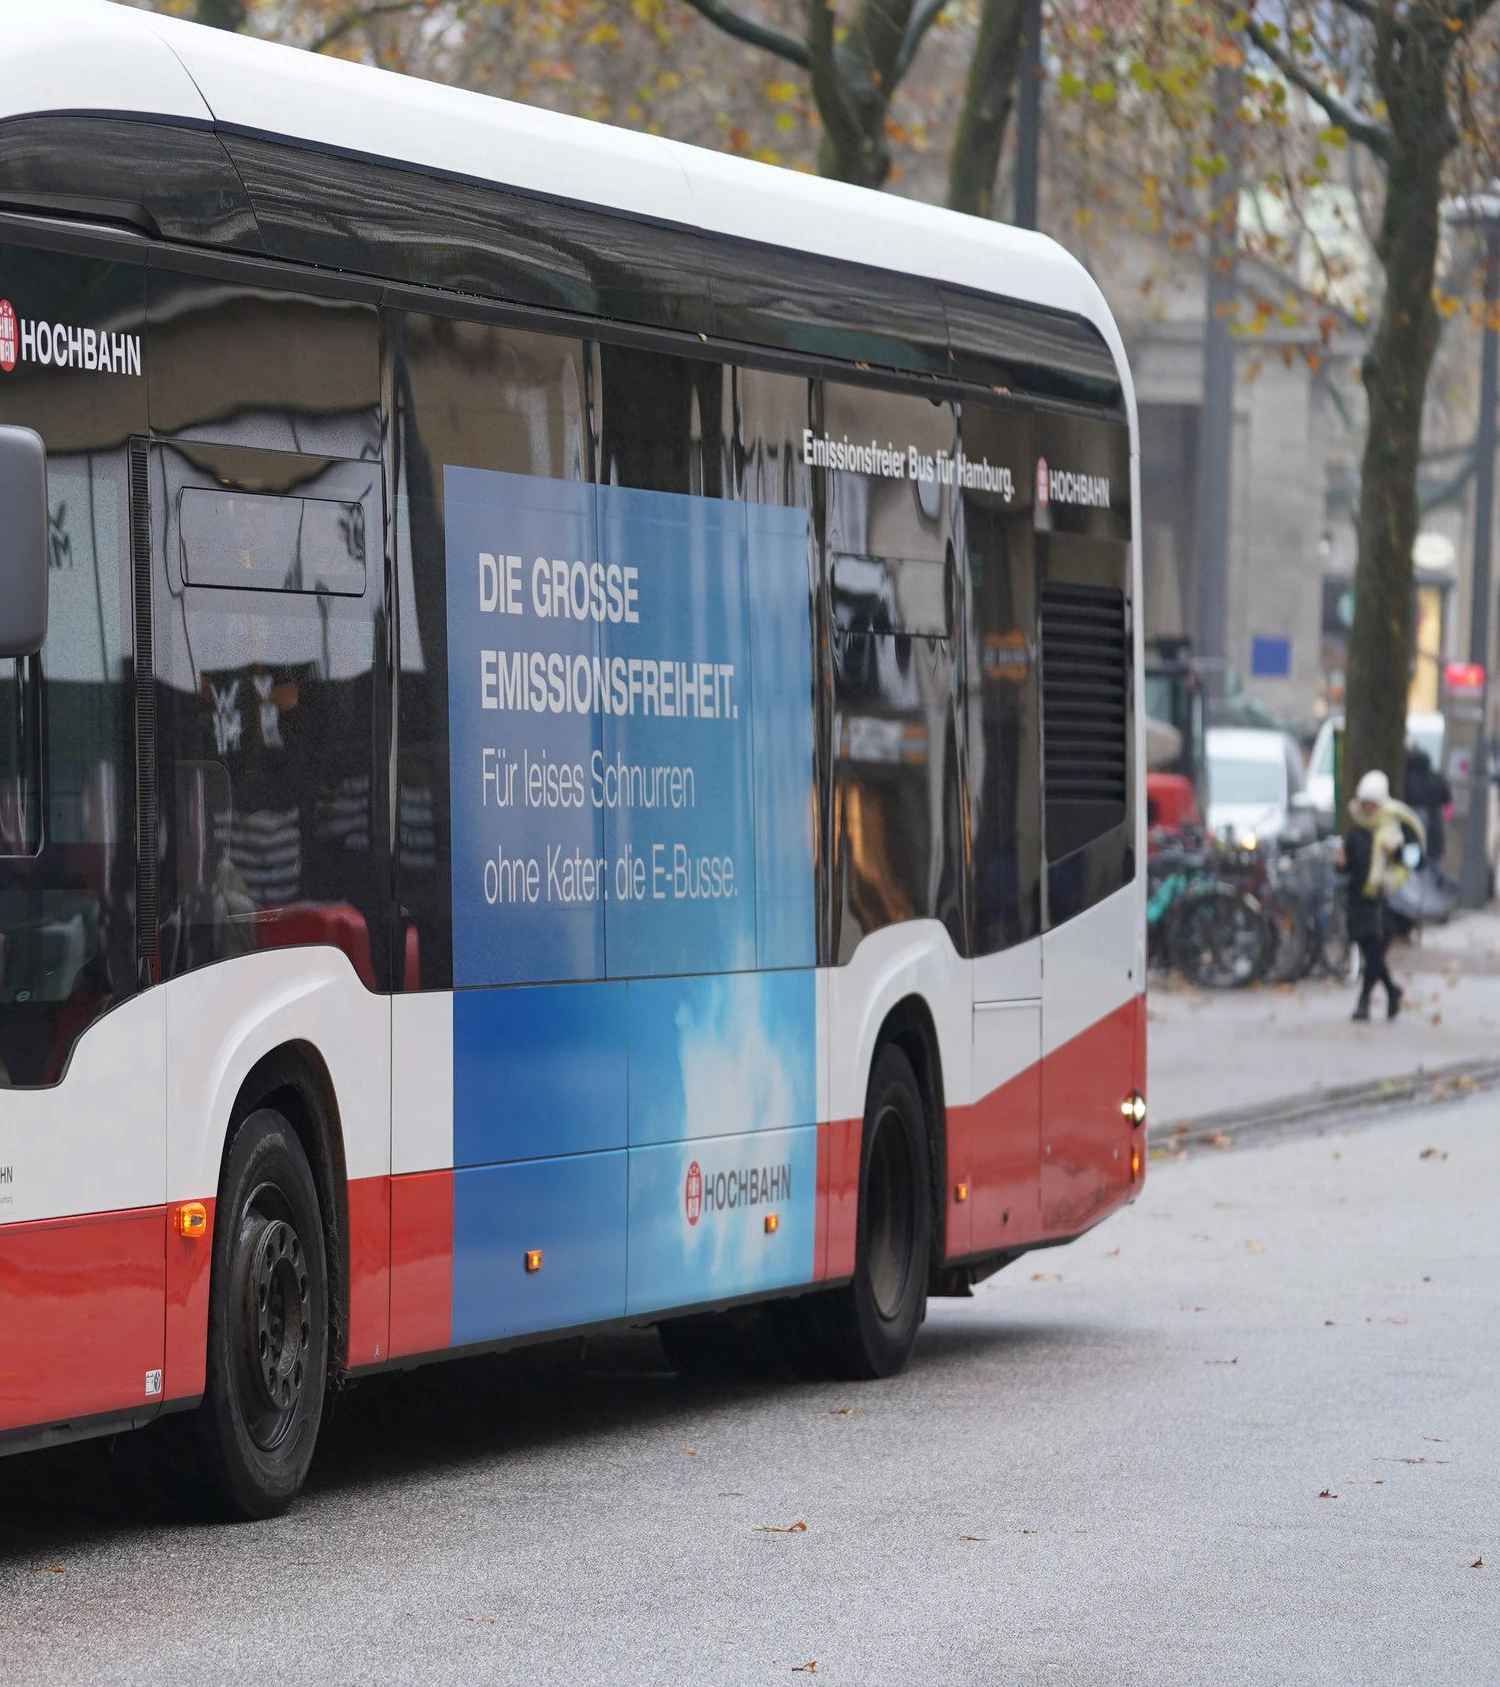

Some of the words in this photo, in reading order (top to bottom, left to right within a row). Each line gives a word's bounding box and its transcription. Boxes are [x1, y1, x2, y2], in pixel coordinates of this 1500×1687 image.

[20, 318, 142, 377] HOCHBAHN
[803, 428, 906, 478] Emissionsfreier
[908, 445, 935, 483] Bus
[936, 449, 956, 485] für
[957, 453, 1016, 503] Hamburg.
[1050, 469, 1110, 508] HOCHBAHN
[478, 552, 523, 615] DIE
[531, 556, 640, 623] GROSSE
[480, 649, 739, 720] EMISSIONSFREIHEIT.
[482, 747, 518, 808] Für
[524, 749, 585, 808] leises
[590, 749, 696, 809] Schnurren
[483, 844, 540, 905] ohne
[547, 844, 609, 902] Kater:
[615, 843, 646, 901] die
[652, 843, 739, 899] E-Busse.
[703, 1163, 792, 1212] HOCHBAHN
